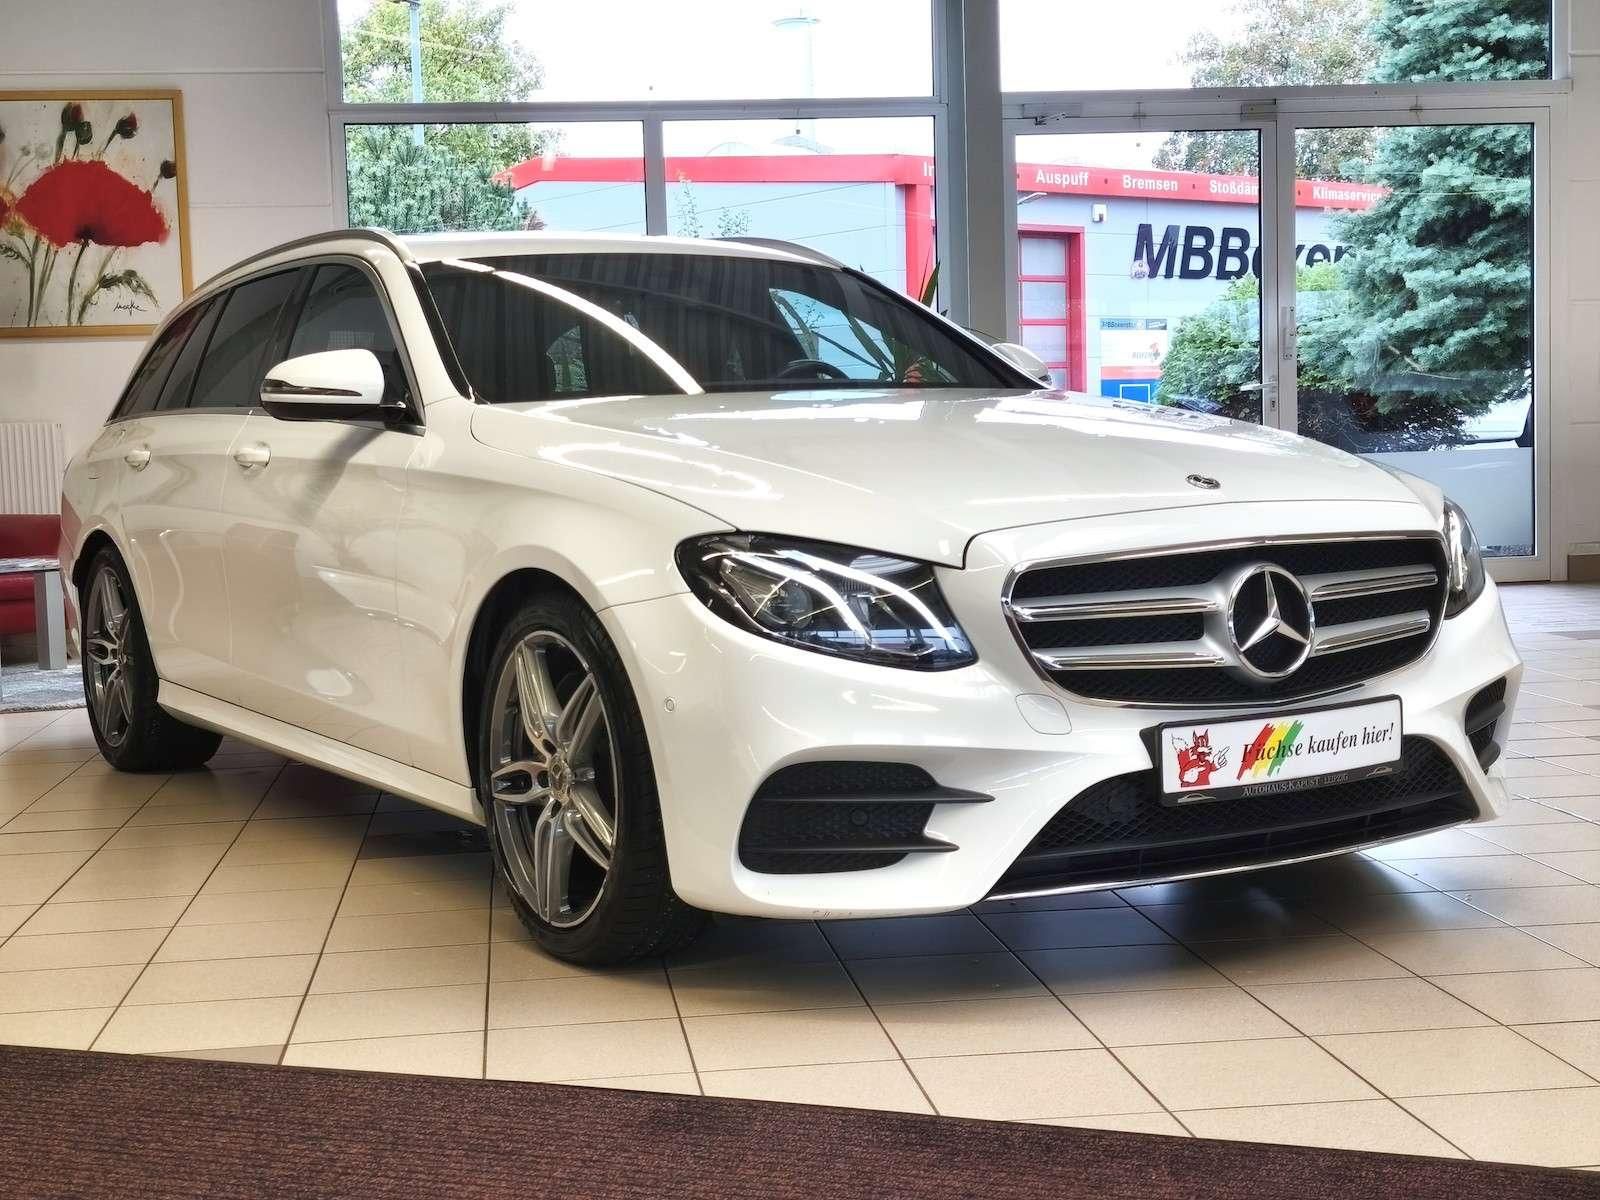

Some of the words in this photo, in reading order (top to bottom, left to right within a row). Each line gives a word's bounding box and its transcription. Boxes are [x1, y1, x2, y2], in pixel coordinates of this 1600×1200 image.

[1035, 168, 1089, 187] Auspuff
[1122, 174, 1179, 192] Bremsen
[1308, 728, 1358, 755] kaufen
[1362, 722, 1395, 746] hier!
